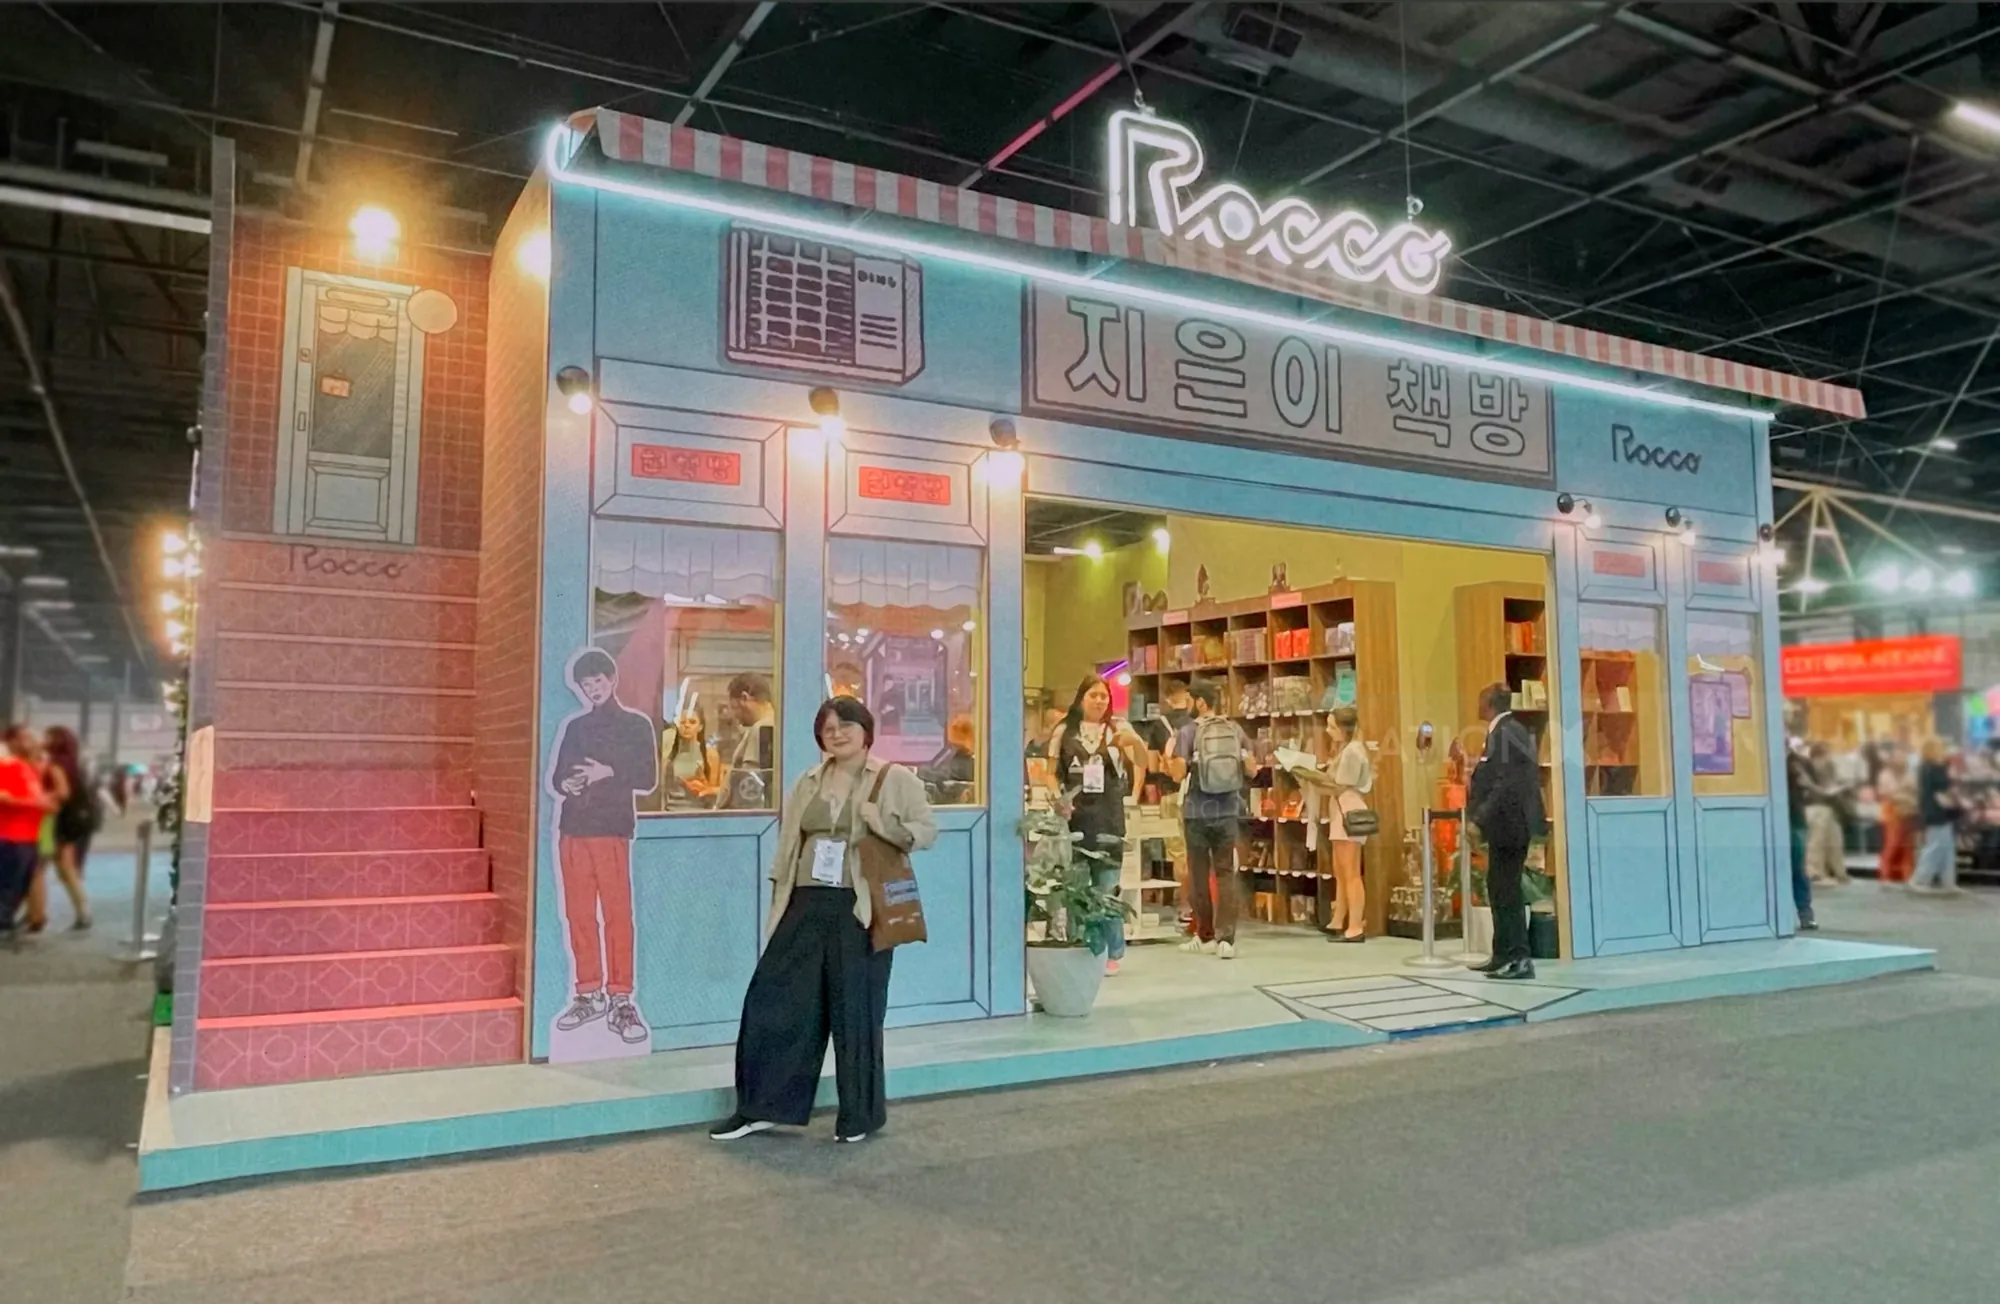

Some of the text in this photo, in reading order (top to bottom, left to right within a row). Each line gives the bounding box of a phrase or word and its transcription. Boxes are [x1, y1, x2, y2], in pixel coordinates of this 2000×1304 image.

[1107, 109, 1452, 295] Rocco
[1064, 295, 1530, 457] 지은이 책방
[1611, 423, 1702, 475] Rocco
[288, 543, 408, 579] Rocco
